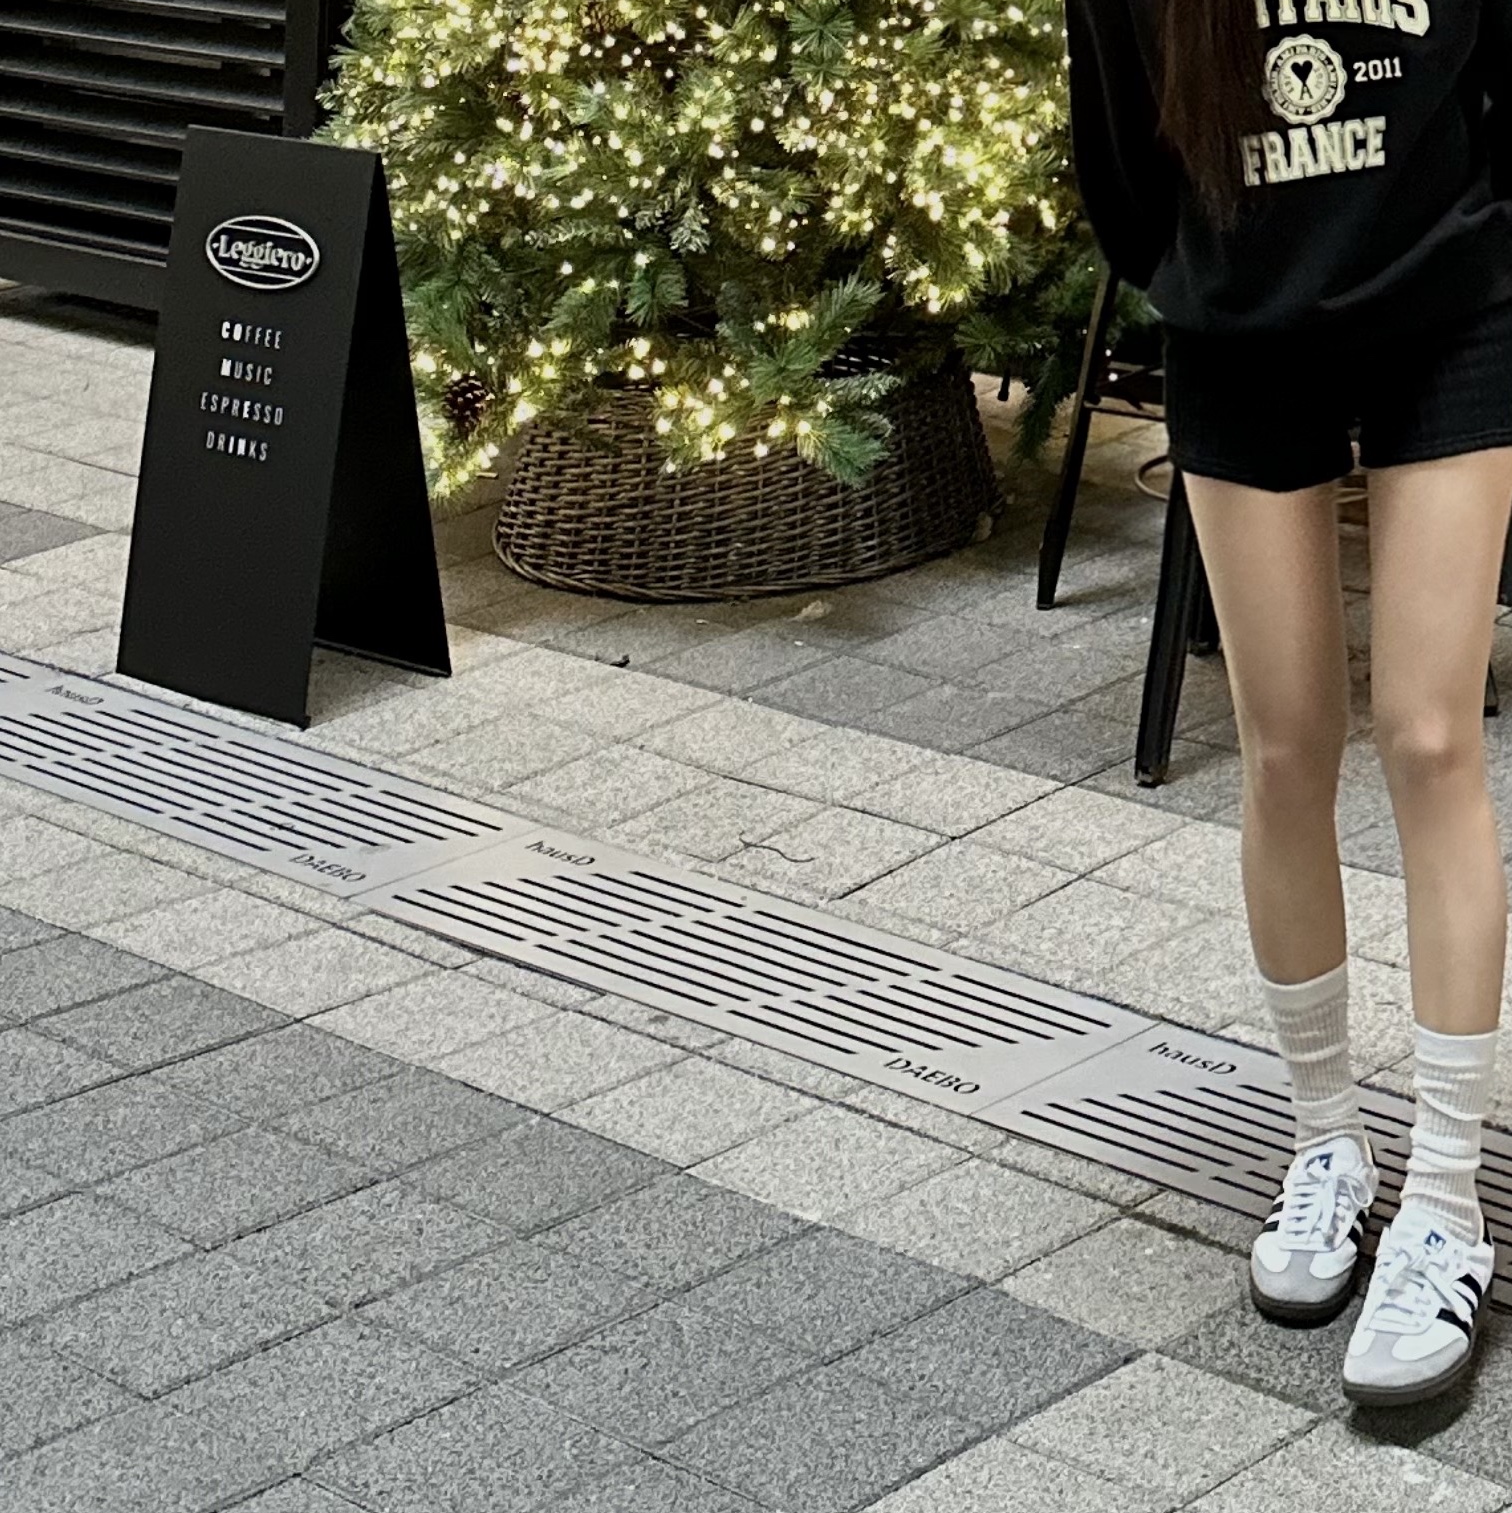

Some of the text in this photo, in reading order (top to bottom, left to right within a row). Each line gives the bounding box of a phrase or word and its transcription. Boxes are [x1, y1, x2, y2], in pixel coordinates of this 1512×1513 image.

[1353, 56, 1402, 82] 2011
[1241, 115, 1386, 186] FRANCE
[218, 234, 305, 271] Leggiero
[221, 321, 282, 350] COFFEE
[220, 358, 273, 385] MUSIC
[200, 391, 284, 426] ESPRESSO
[205, 431, 268, 461] DRINKS
[289, 853, 366, 883] DAEBO
[524, 840, 595, 866] hausD
[1149, 1041, 1237, 1075] hausD
[883, 1057, 980, 1094] DAEBO
